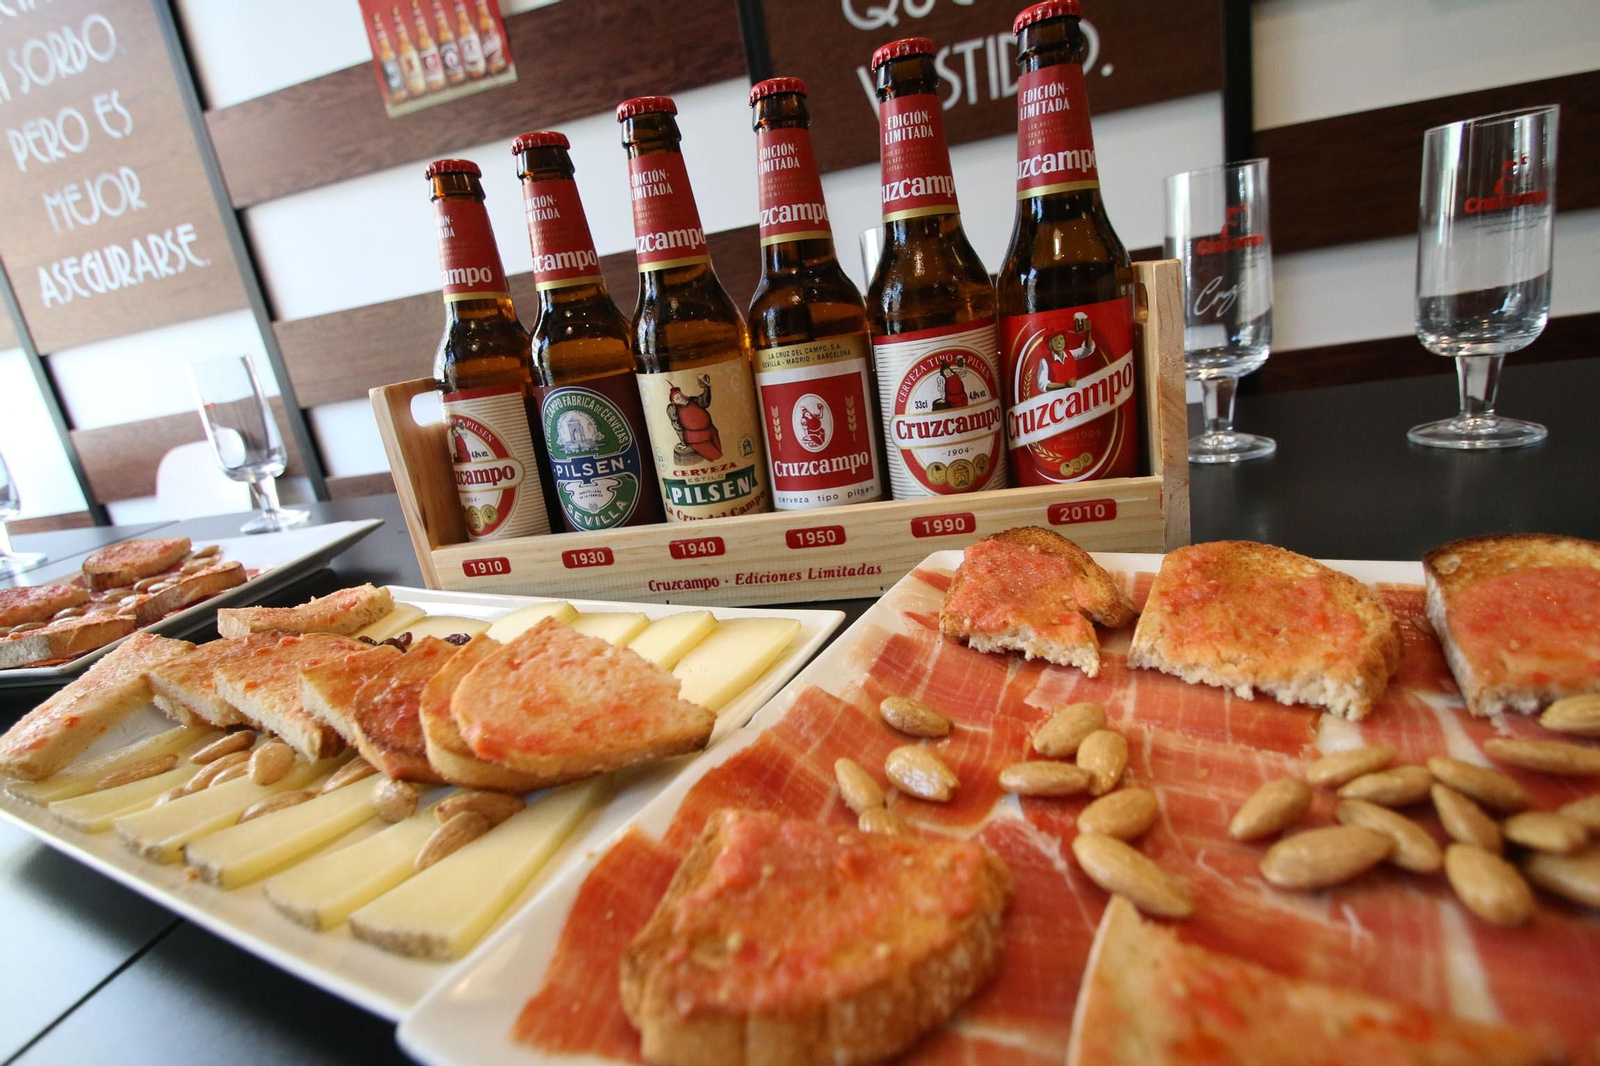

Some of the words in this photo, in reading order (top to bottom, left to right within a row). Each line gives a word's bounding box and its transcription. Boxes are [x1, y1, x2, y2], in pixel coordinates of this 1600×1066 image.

[8, 13, 117, 94] SORDO
[1020, 97, 1070, 121] LIMITADA
[7, 107, 90, 173] PERO
[93, 89, 133, 139] ES
[884, 124, 934, 145] LIMITADA
[42, 166, 147, 234] MEJOR
[38, 223, 211, 308] ASEGURARSE.
[762, 360, 781, 369] SEVILLA
[786, 356, 811, 365] MADRID
[816, 349, 851, 360] BARCELONA
[776, 351, 790, 359] CRUZ
[792, 348, 803, 357] DEL
[898, 364, 927, 403] CERVEZA
[967, 355, 990, 380] PILSEN
[1007, 361, 1133, 441] Cruzcampo
[466, 420, 494, 443] PILSEN
[600, 409, 629, 445] CERVEZAS
[895, 404, 1001, 441] Cruzcampo
[556, 456, 625, 478] PILSEN
[672, 461, 738, 477] CERVEZA
[774, 451, 869, 478] Cruzcampo
[671, 476, 750, 504] PILSEN
[687, 473, 725, 484] ESTILO
[778, 495, 810, 504] cerveza
[817, 491, 839, 503] tipo
[847, 484, 874, 499] pilsen
[566, 500, 627, 526] SEVILLA
[1059, 504, 1106, 523] 2010
[922, 517, 966, 534] 1990
[679, 540, 717, 556] 1940
[796, 530, 837, 546] 1950
[470, 561, 503, 574] 1910
[570, 551, 605, 566] 1930
[648, 576, 720, 593] Cruzcampo
[735, 569, 802, 586] Ediciones
[808, 563, 883, 581] Limitadas
